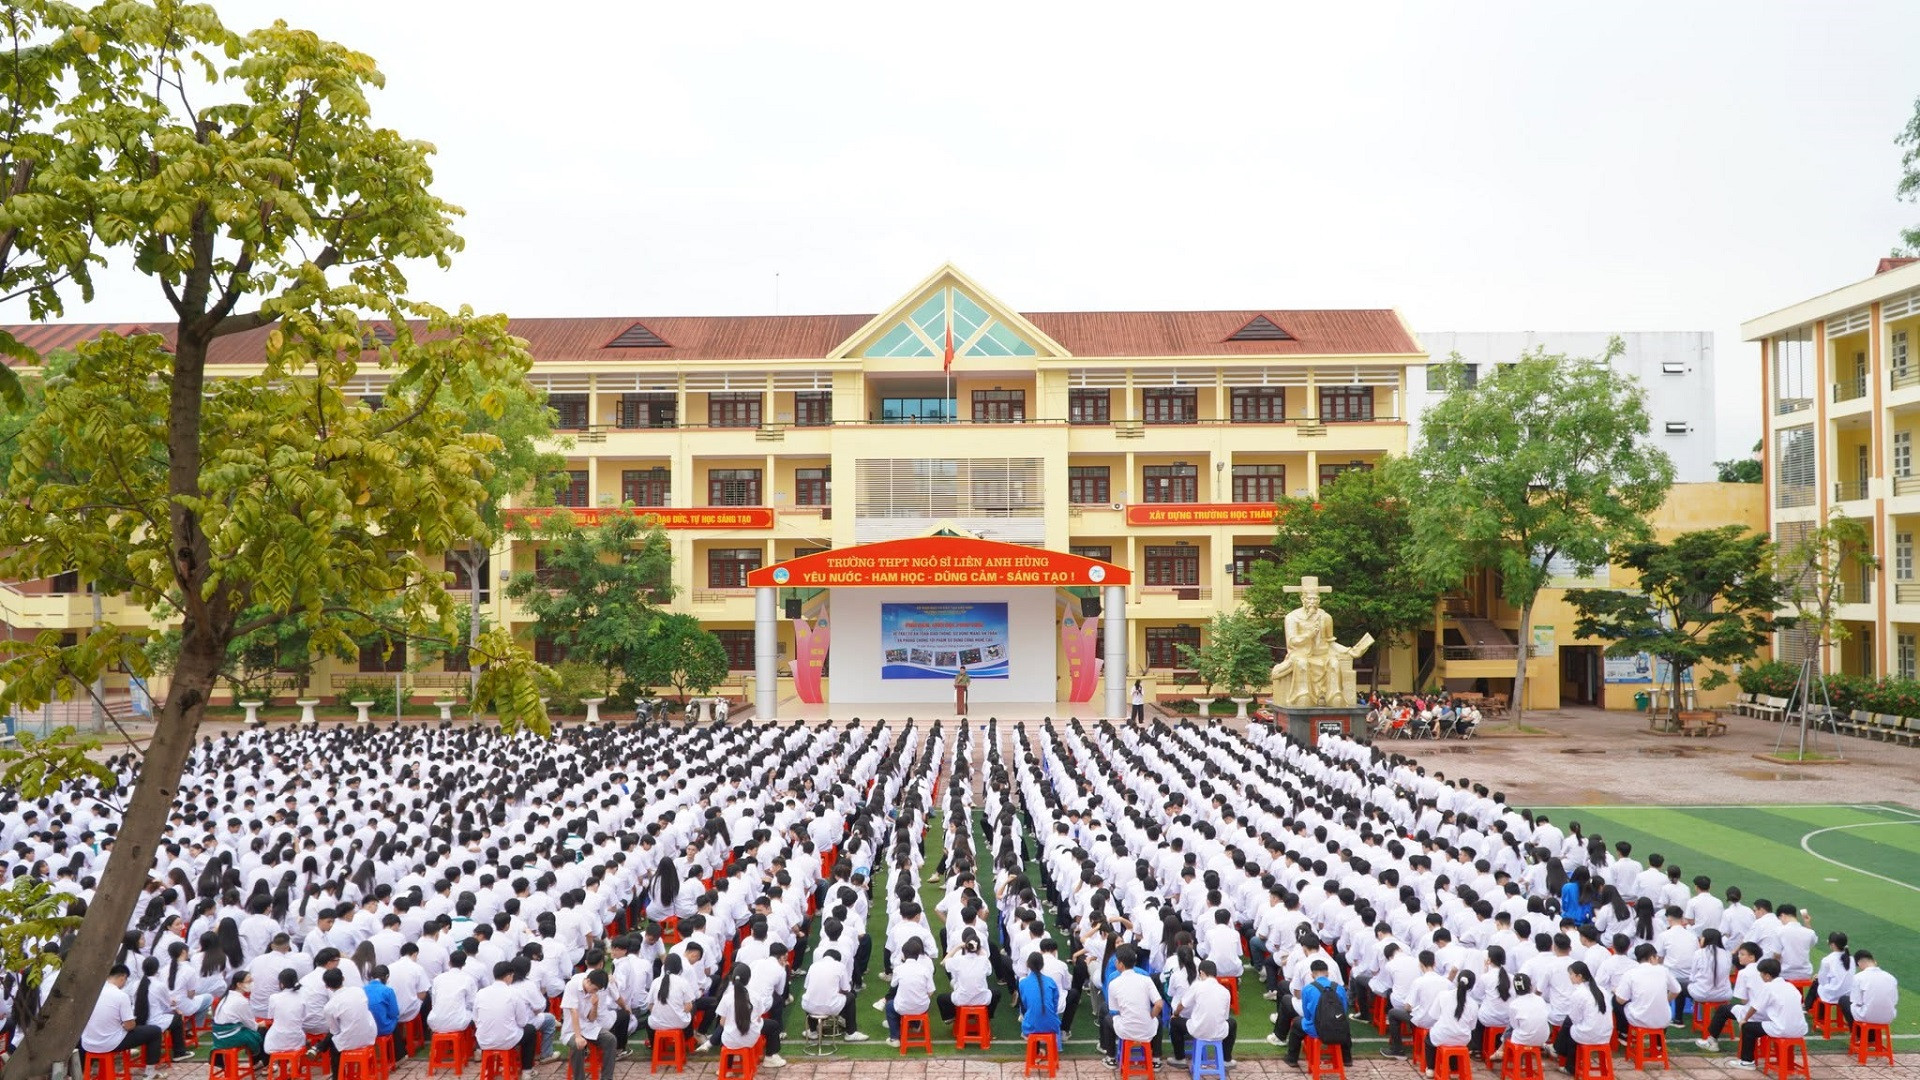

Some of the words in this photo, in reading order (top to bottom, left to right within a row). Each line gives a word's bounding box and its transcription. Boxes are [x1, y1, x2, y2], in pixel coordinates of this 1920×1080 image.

[701, 514, 716, 525] HỌC
[717, 512, 737, 524] SÁNG
[738, 514, 752, 525] TẠO
[1149, 509, 1165, 520] XÂY
[1167, 510, 1192, 521] DỰNG
[1194, 508, 1228, 520] TRƯỜNG
[1230, 510, 1247, 521] HỌC
[827, 555, 875, 568] TRƯỜNG
[878, 557, 909, 568] THPT
[911, 555, 938, 568] NGÔ
[954, 555, 982, 568] LIÊN
[985, 557, 1011, 567] ANH
[1014, 555, 1050, 567] HÙNG
[803, 570, 826, 583] YÊU
[829, 571, 862, 583] NƯỚC
[871, 572, 898, 583] HAM
[900, 572, 925, 585] HỌC
[934, 570, 967, 582] DŨNG
[970, 570, 997, 582] CẢM
[1006, 569, 1040, 582] SÁNG
[1042, 571, 1068, 584] TẠO
